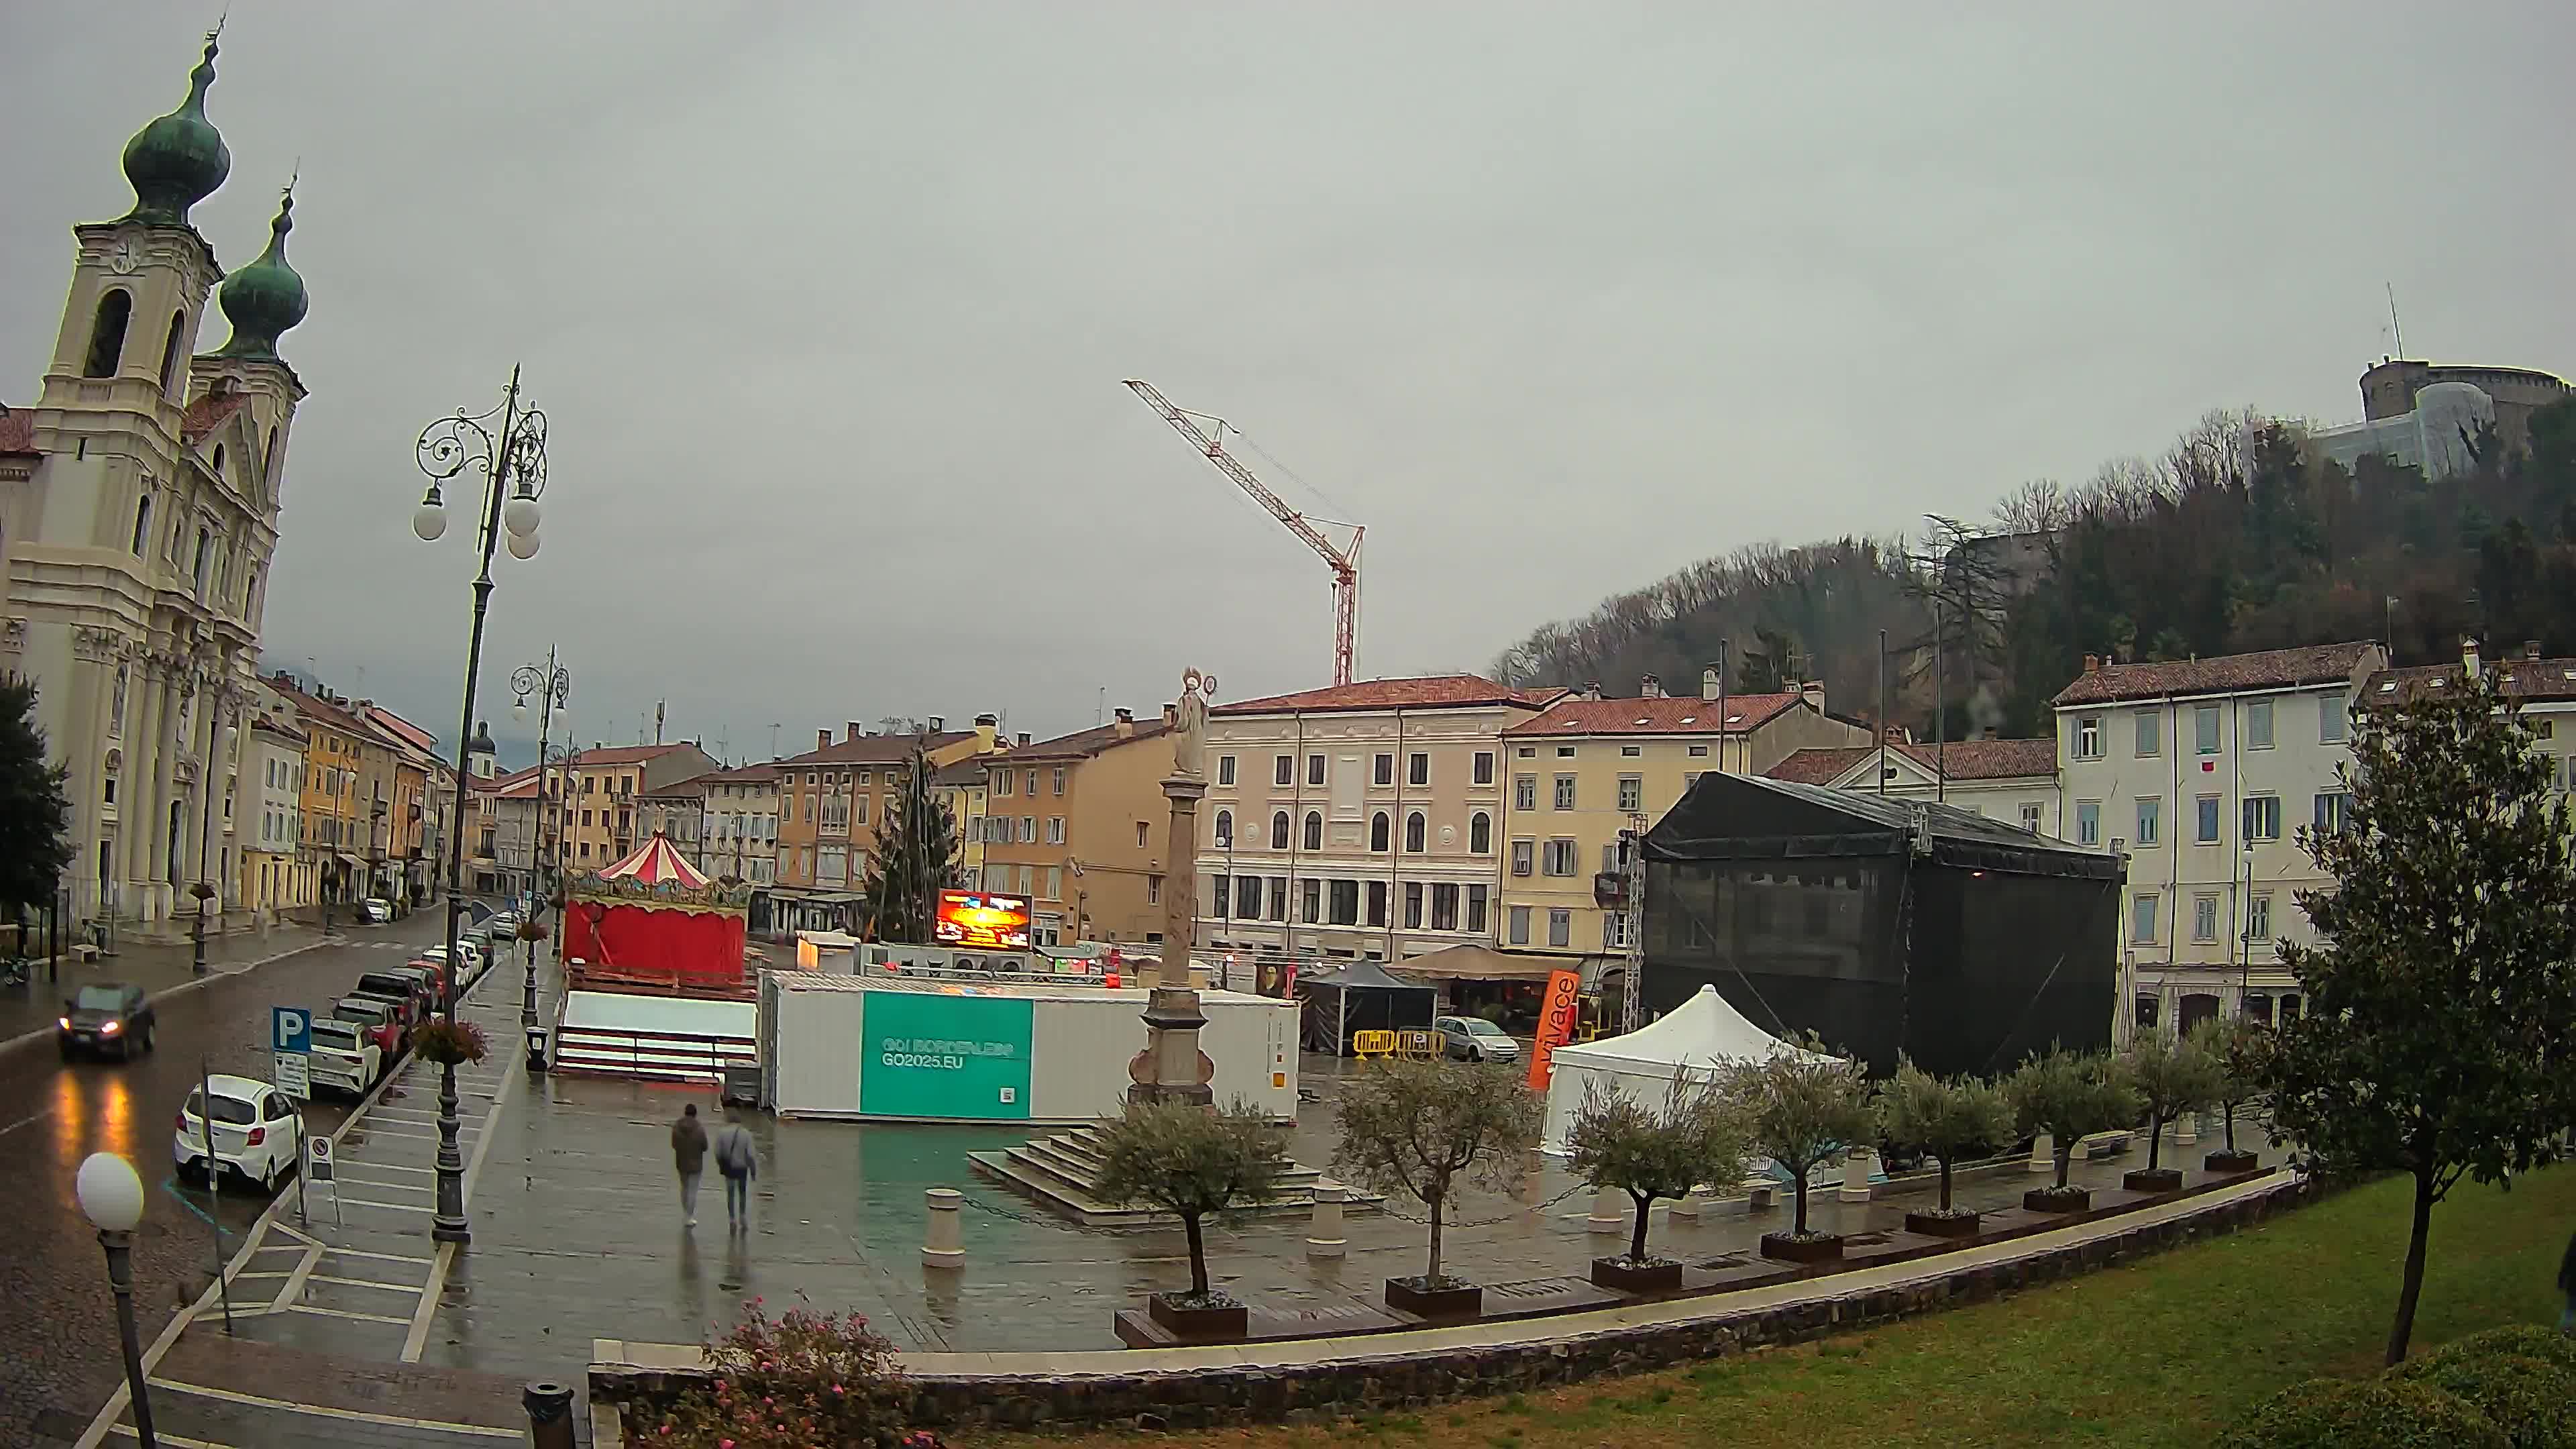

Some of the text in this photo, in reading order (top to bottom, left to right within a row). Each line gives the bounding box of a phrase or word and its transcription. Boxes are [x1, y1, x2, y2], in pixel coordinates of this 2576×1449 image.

[279, 1010, 304, 1046] P
[1540, 977, 1574, 1062] vivace
[881, 1053, 963, 1069] GO2025.EU
[912, 1038, 1014, 1057] BORDELE
